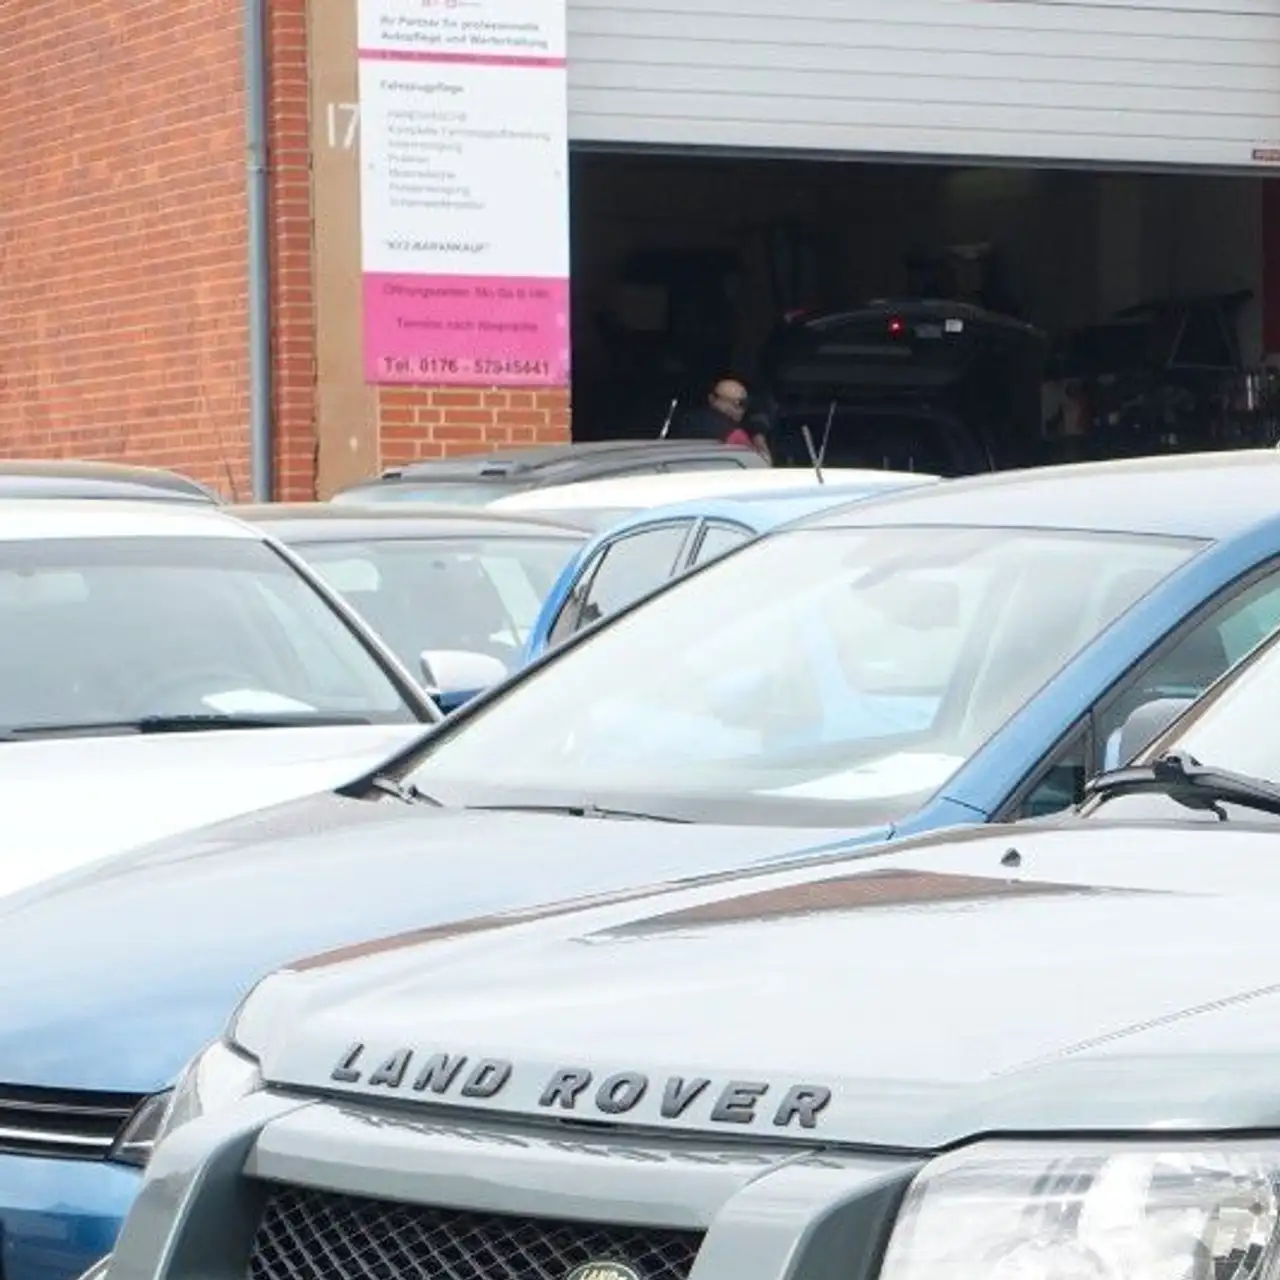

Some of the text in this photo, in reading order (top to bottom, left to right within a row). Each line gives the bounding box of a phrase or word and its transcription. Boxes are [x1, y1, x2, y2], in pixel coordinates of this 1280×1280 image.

[328, 103, 360, 149] 17
[331, 1043, 832, 1129] LAND ROVER
